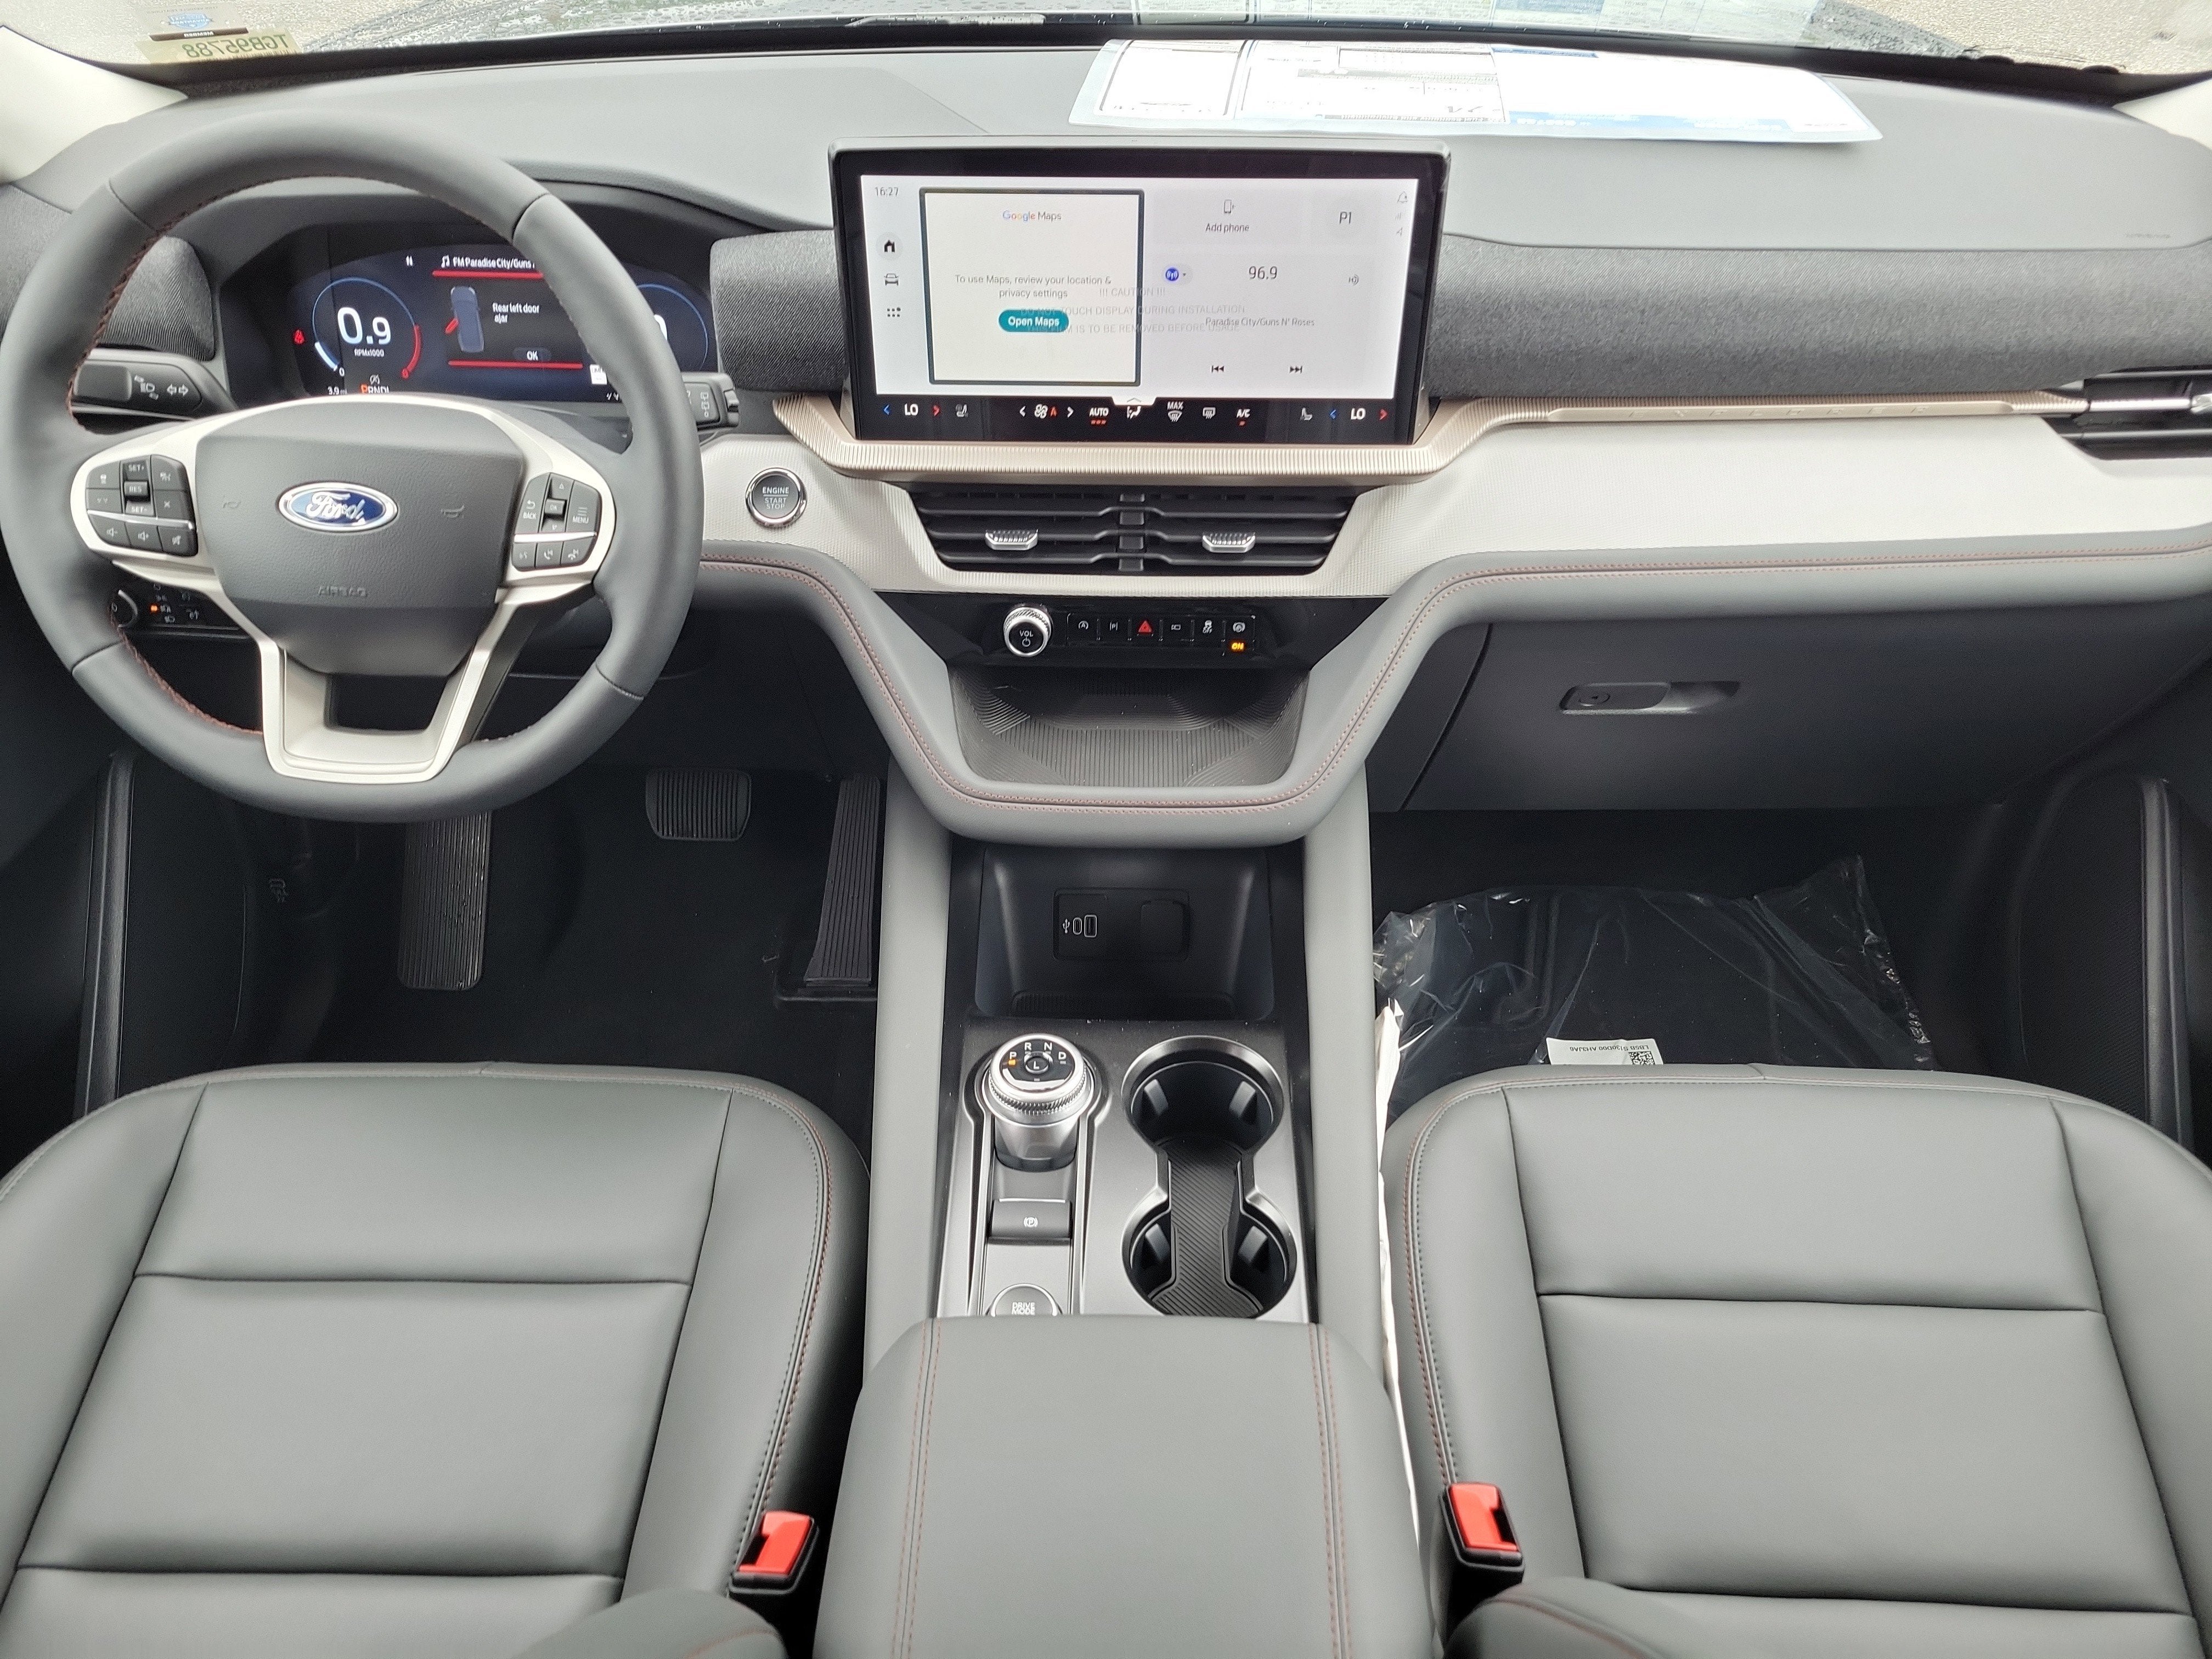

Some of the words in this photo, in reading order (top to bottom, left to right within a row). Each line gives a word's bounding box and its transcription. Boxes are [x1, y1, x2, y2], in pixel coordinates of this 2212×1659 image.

[875, 187, 898, 196] 16:27
[1003, 210, 1035, 221] Google
[1038, 211, 1062, 222] Maps
[1205, 223, 1222, 233] Add
[1223, 223, 1249, 233] phone
[453, 257, 465, 267] FM
[465, 257, 496, 268] Paradise
[1249, 266, 1278, 280] 96.9
[956, 275, 965, 284] To
[986, 275, 1012, 285] Maps,
[1045, 277, 1064, 285] your
[1067, 275, 1102, 284] location
[999, 289, 1030, 298] privacy
[1034, 289, 1068, 299] settings
[1111, 287, 1153, 297] CAUTION
[493, 302, 509, 313] Rear
[510, 302, 522, 313] left
[523, 303, 539, 314] door
[1060, 307, 1092, 315] TOUCH
[1096, 306, 1135, 315] DISPLAY
[1137, 306, 1175, 314] DURING
[1179, 305, 1245, 314] INSTALLATION
[494, 313, 508, 324] ajar
[1008, 316, 1032, 327] Open
[1035, 317, 1059, 327] Maps
[1206, 318, 1239, 326] Paradise
[1241, 318, 1279, 327] City/Guns
[1292, 318, 1315, 326] Roses
[337, 306, 391, 345] 0.9
[1103, 324, 1116, 333] BE
[1119, 324, 1164, 333] REMOVED
[1168, 323, 1205, 332] BEFORE
[527, 351, 539, 361] OK
[904, 403, 919, 416] LO
[1167, 402, 1183, 410] MAX
[1089, 407, 1109, 416] AUTO
[1237, 409, 1251, 418] A/C
[1350, 408, 1366, 420] LO
[306, 492, 366, 521] Ford
[573, 516, 589, 524] MENU
[1231, 642, 1244, 651] ON
[1024, 1042, 1031, 1051] R
[1044, 1042, 1052, 1051] N
[1034, 1061, 1039, 1069] L
